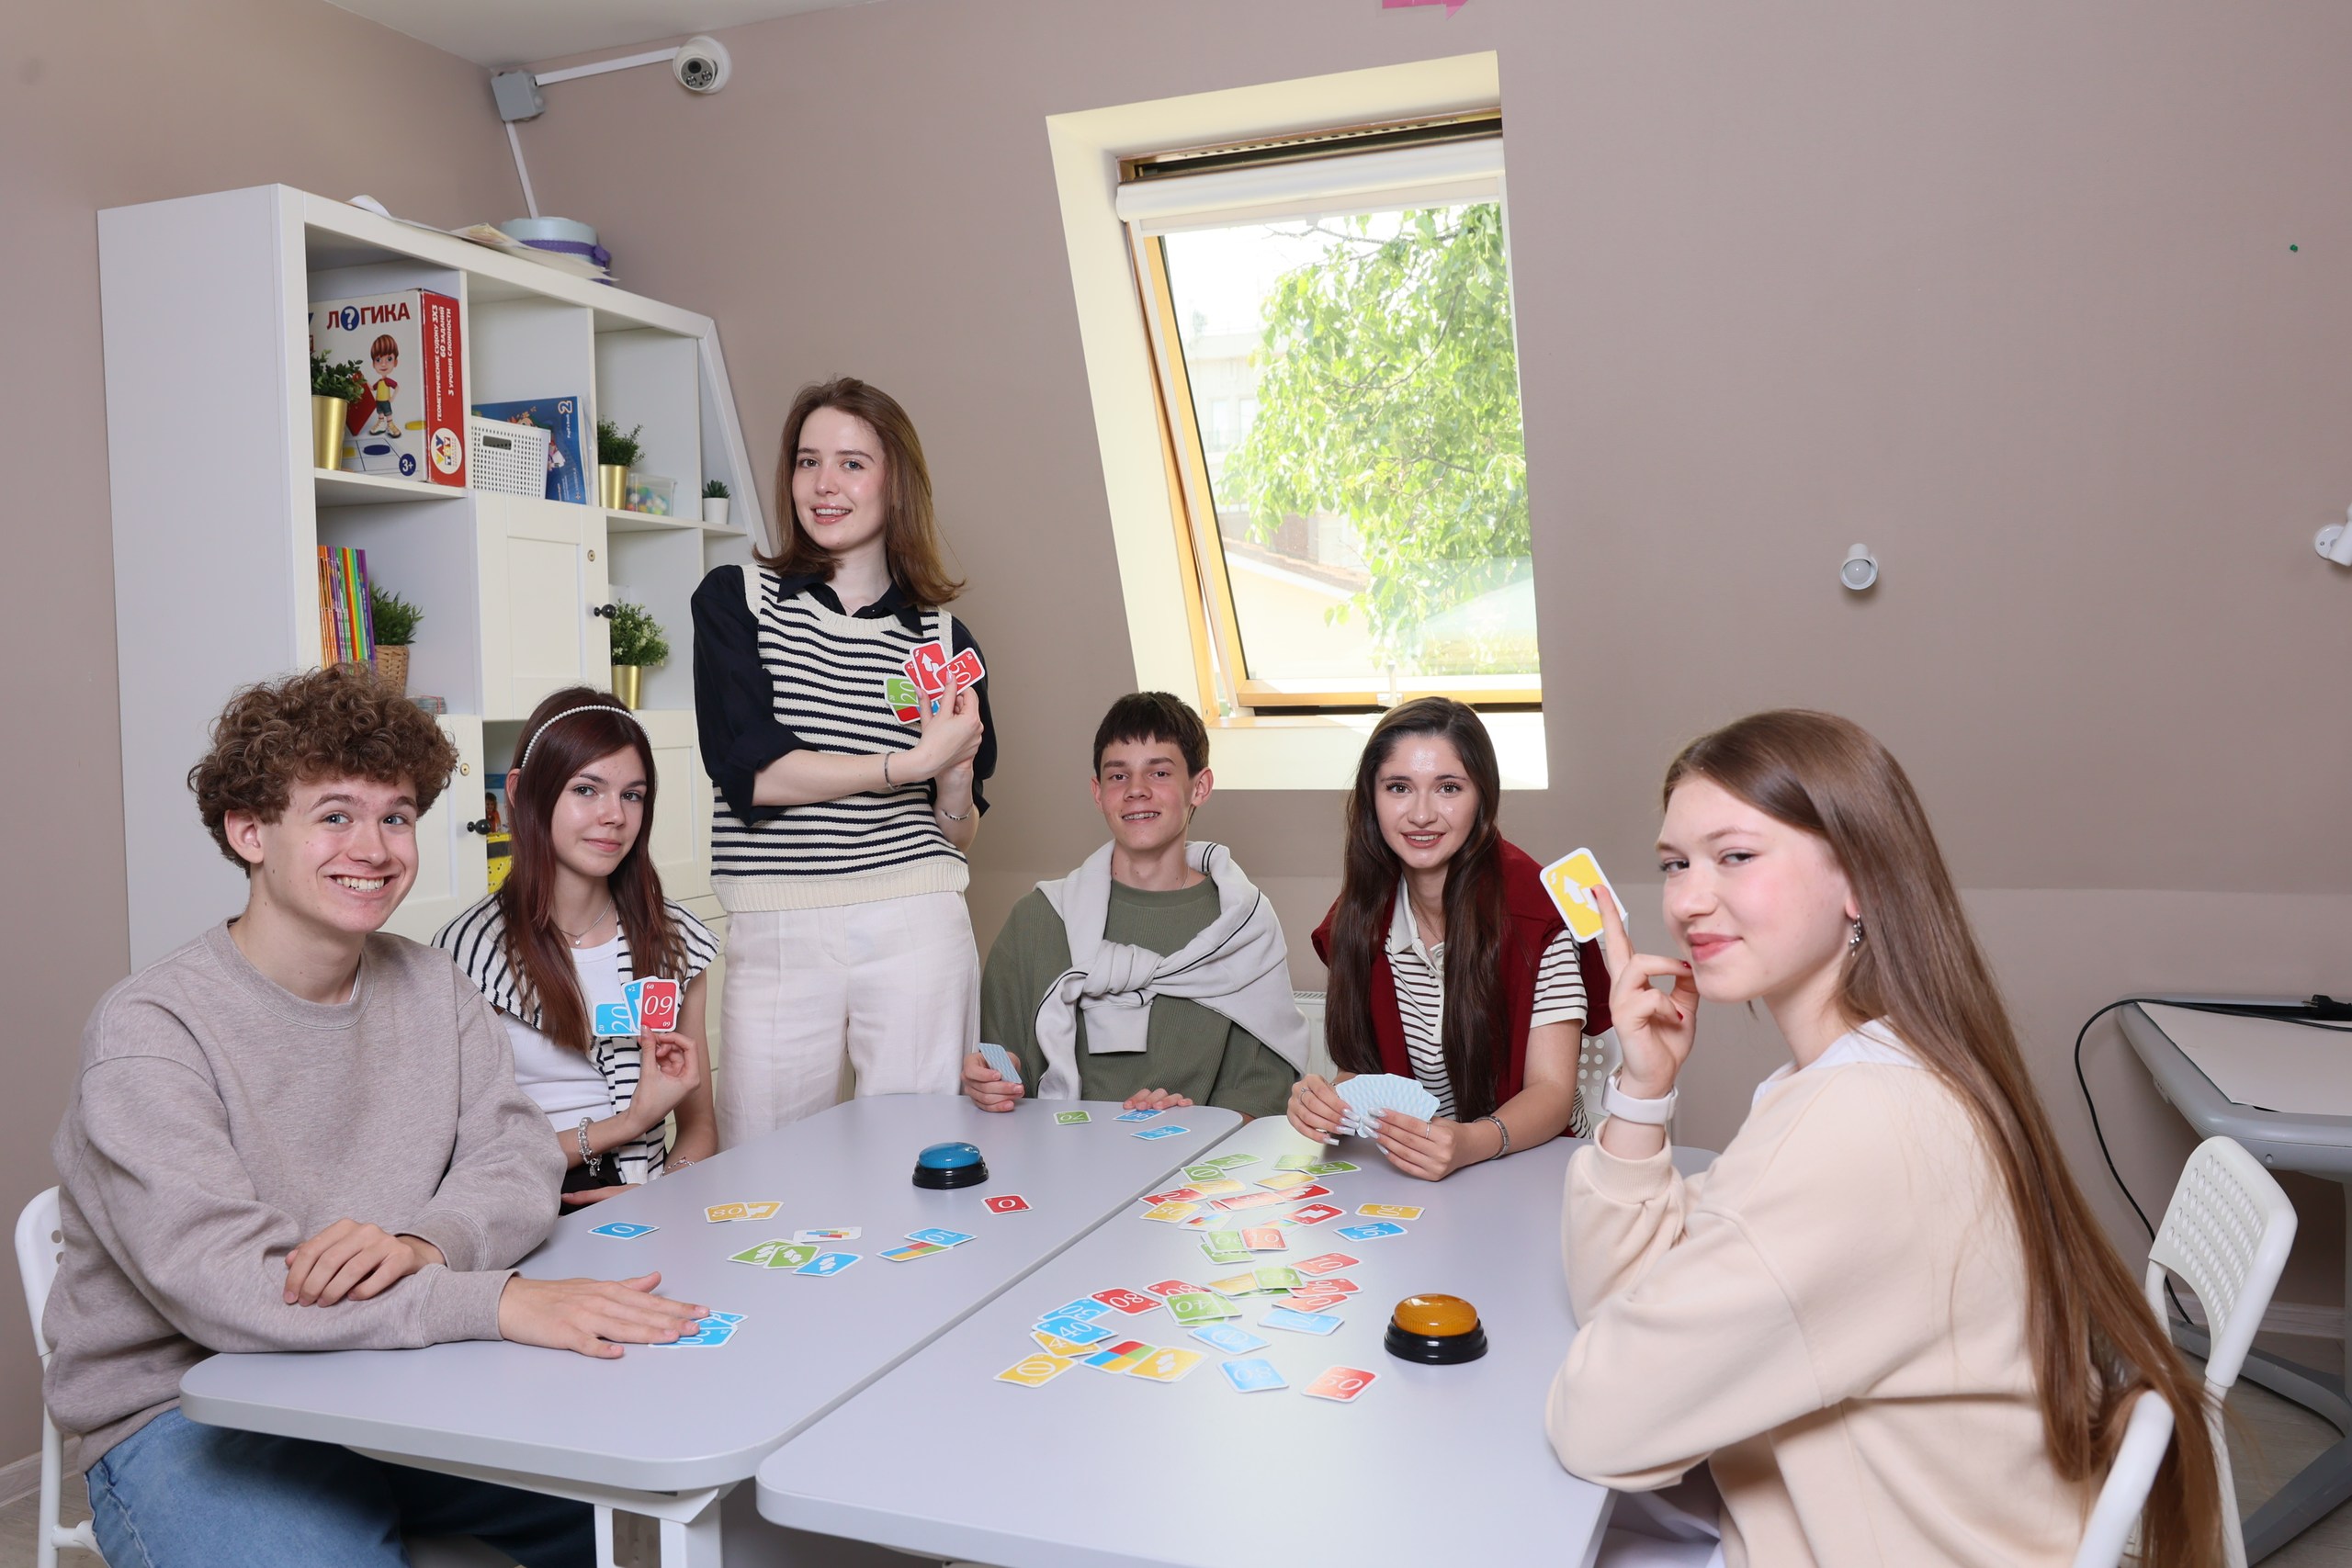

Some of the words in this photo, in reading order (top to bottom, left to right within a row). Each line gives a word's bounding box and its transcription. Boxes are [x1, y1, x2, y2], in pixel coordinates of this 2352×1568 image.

[440, 344, 446, 358] 60
[558, 400, 572, 414] 2
[401, 458, 413, 472] 3+
[946, 660, 972, 685] 50
[899, 681, 919, 704] 20
[611, 1006, 634, 1032] 20
[1059, 1322, 1092, 1337] 40
